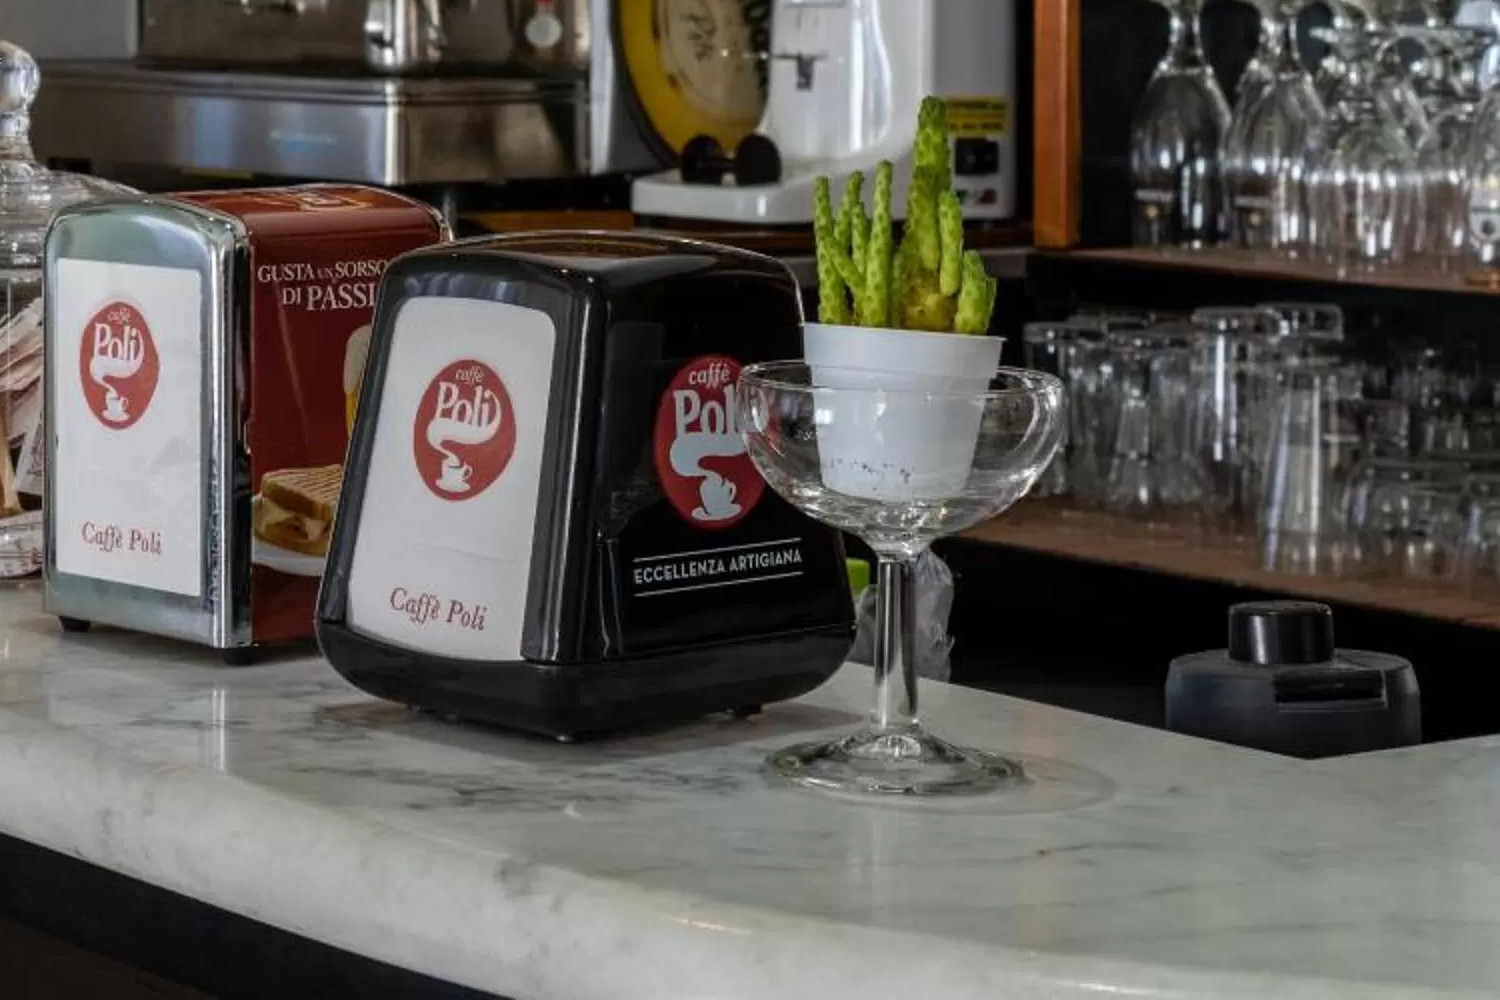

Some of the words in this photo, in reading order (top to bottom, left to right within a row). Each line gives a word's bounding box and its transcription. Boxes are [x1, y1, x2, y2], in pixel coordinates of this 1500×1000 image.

[257, 263, 315, 283] GUSTA
[282, 287, 302, 305] DI
[306, 281, 376, 311] PASSI
[94, 322, 144, 362] Poli
[688, 362, 731, 389] caffè
[435, 381, 501, 430] Poli
[129, 527, 162, 556] Poli
[633, 559, 725, 584] ECCELLENZA
[729, 548, 802, 572] ARTIGIANA
[446, 599, 488, 631] Poli
